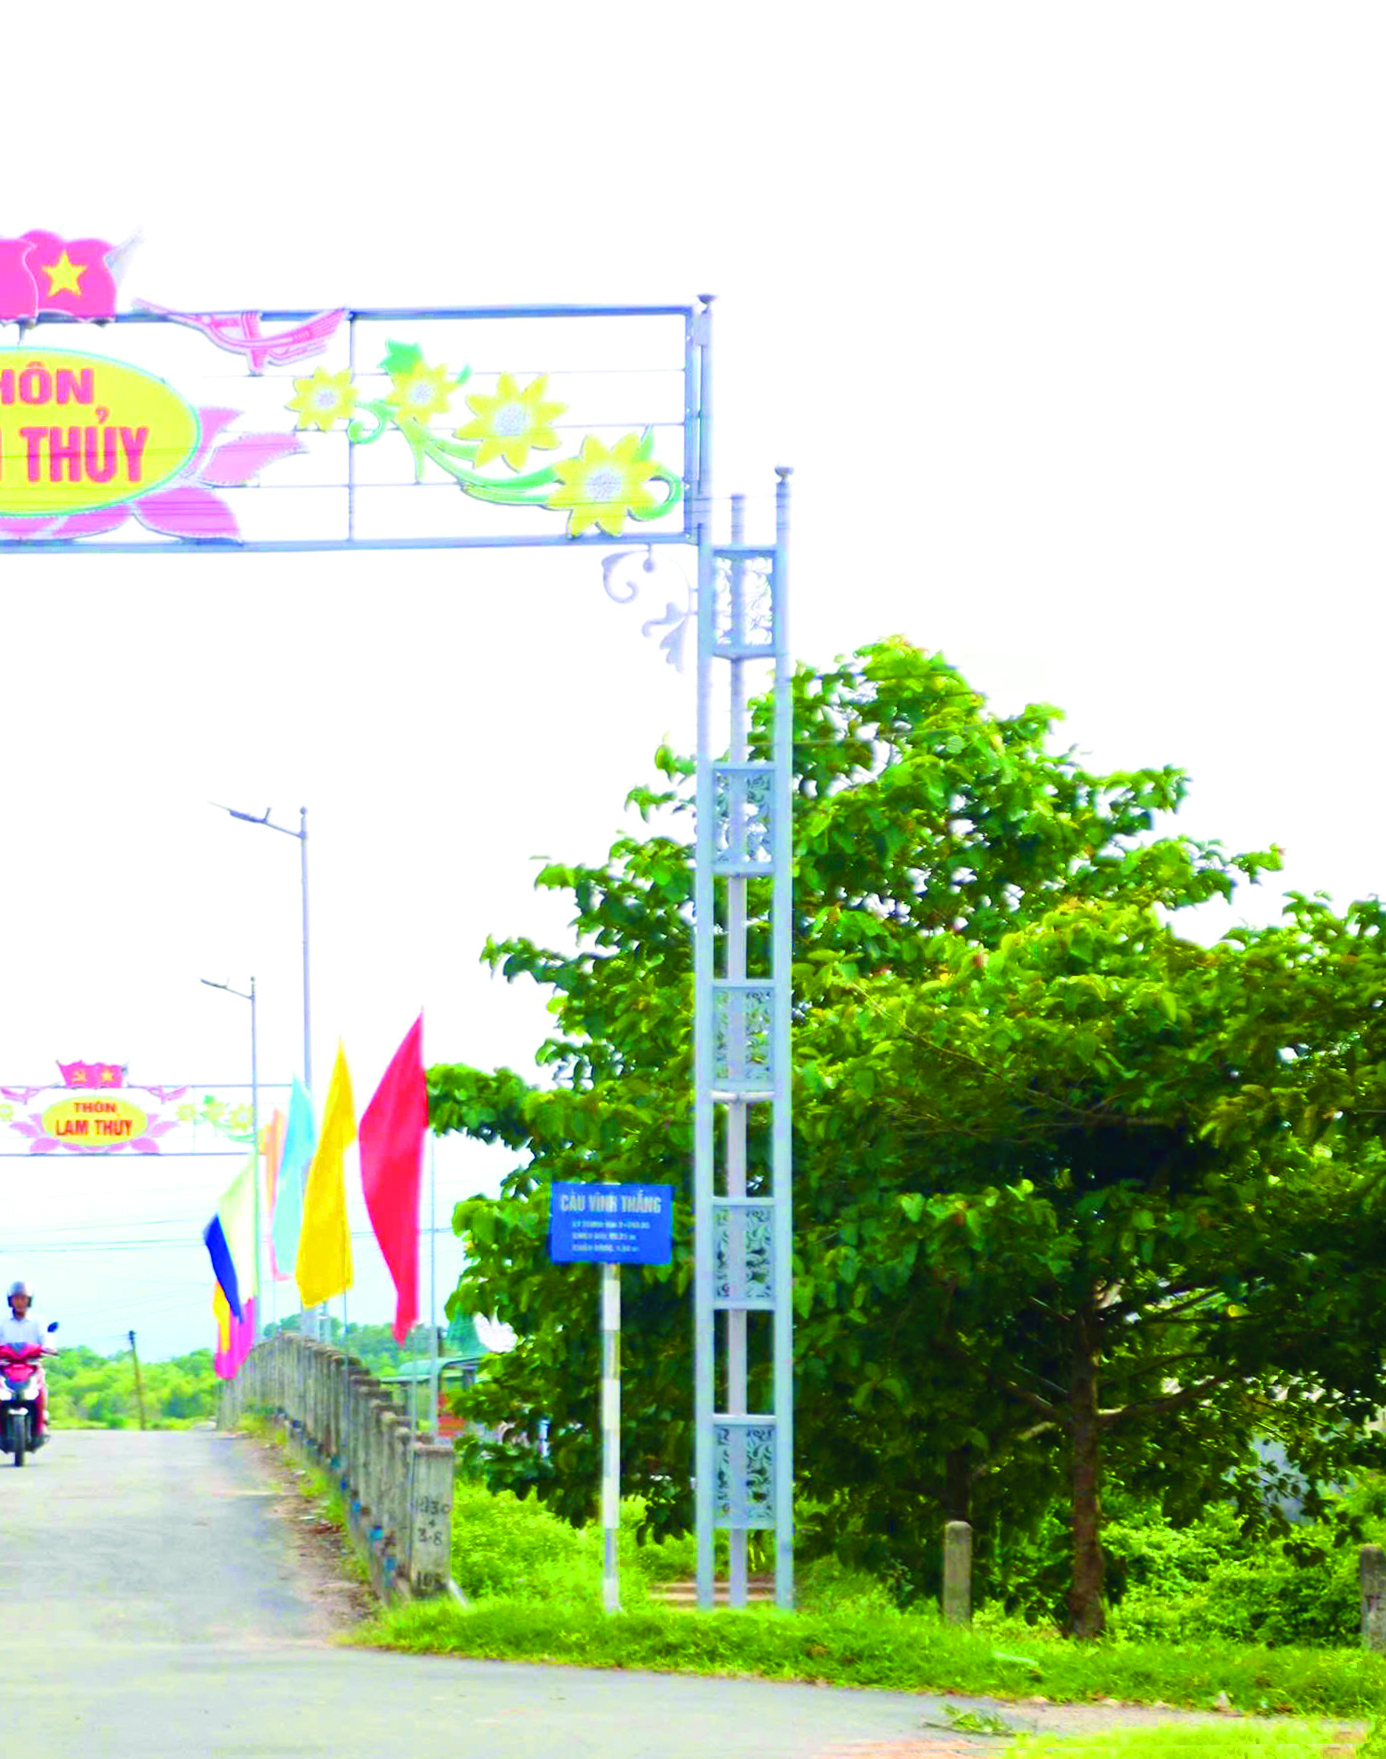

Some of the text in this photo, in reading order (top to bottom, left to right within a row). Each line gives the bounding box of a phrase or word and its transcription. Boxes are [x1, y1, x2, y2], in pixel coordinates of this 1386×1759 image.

[18, 406, 149, 482] THỦY
[73, 1101, 117, 1113] THÔN
[56, 1119, 89, 1136] LAM
